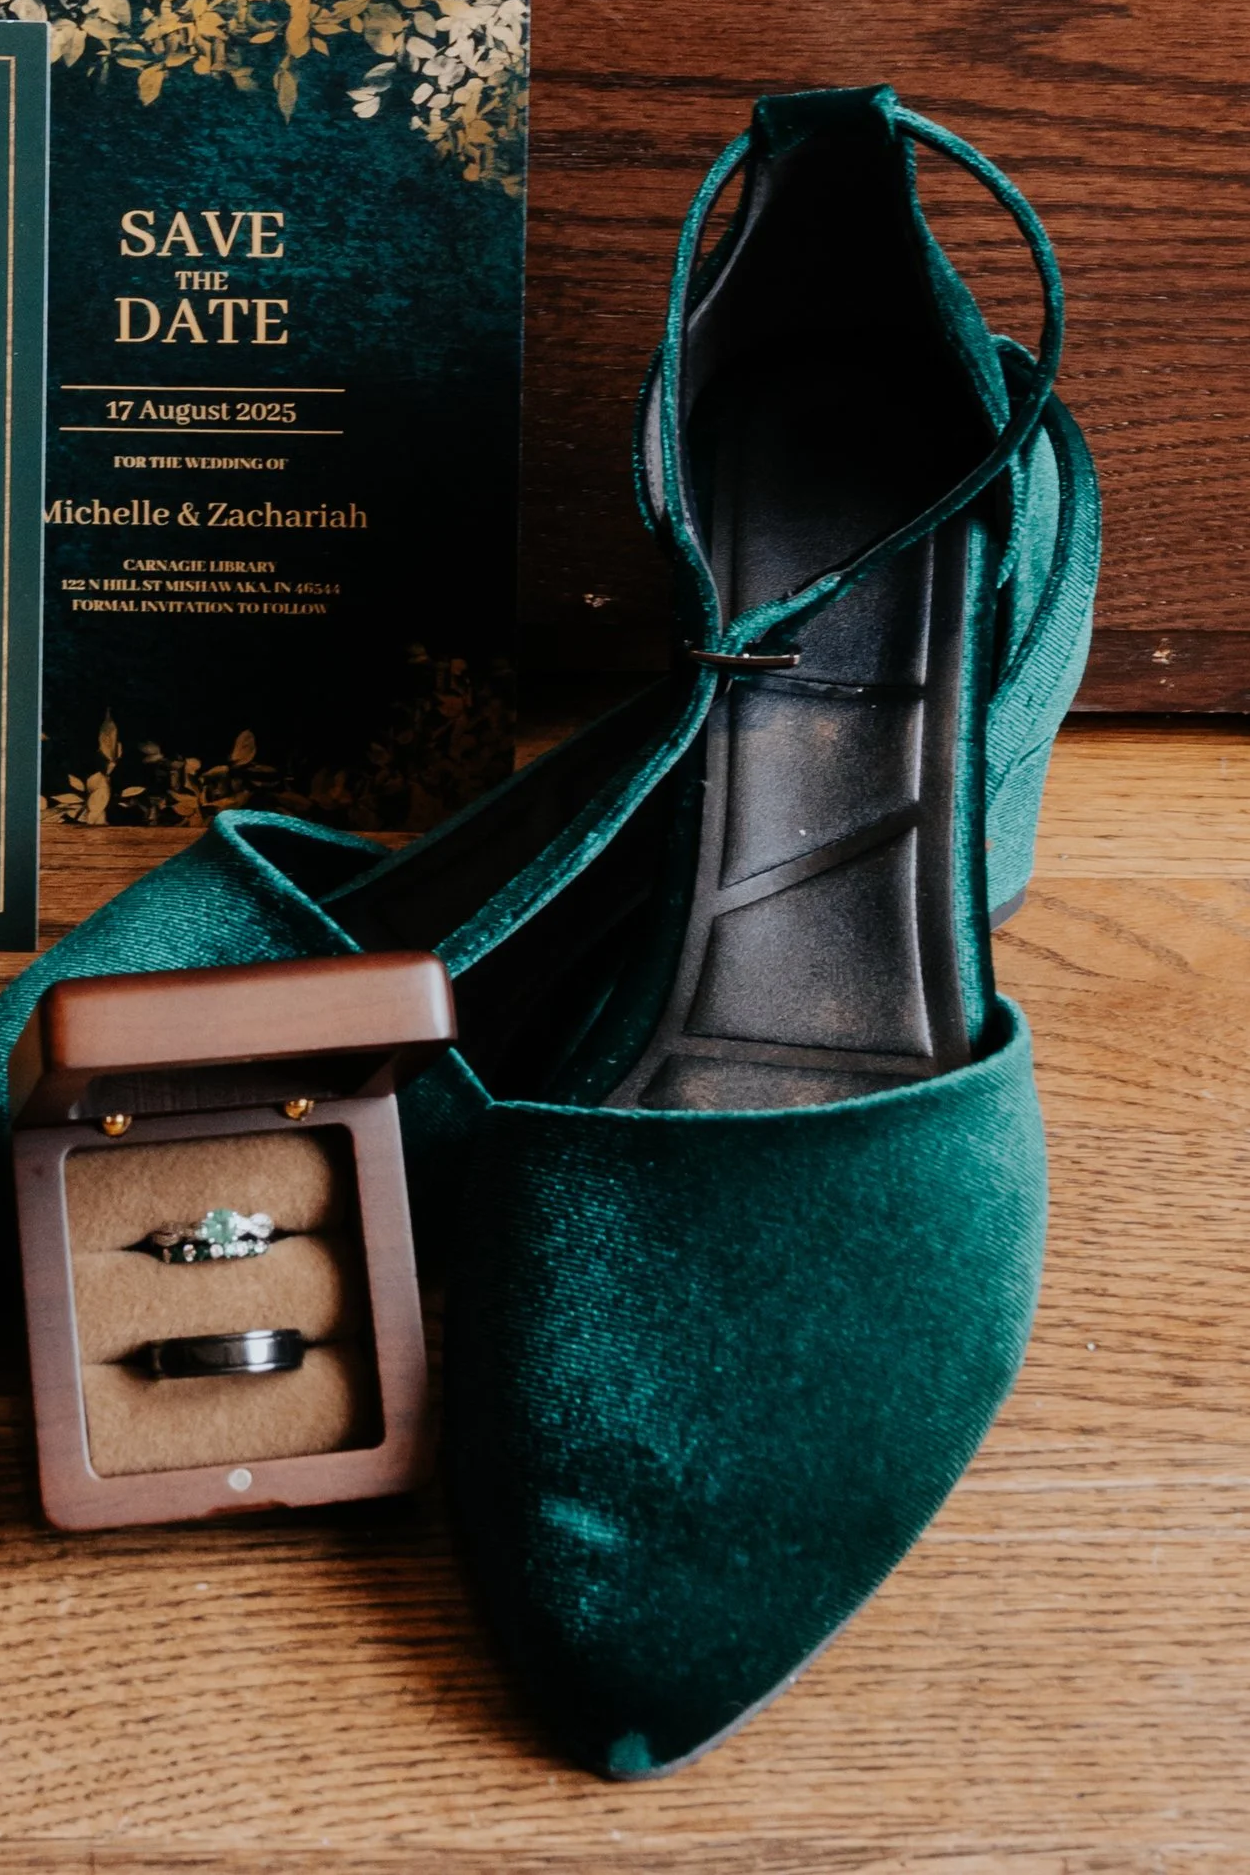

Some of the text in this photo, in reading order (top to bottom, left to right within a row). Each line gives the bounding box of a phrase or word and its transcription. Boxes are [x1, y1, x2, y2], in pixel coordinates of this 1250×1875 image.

[120, 210, 284, 258] SAVE
[175, 271, 229, 291] THE
[115, 297, 288, 344] DATE
[106, 400, 297, 425] 17 August 2025
[114, 456, 289, 471] FOR THE WEDDING OF
[42, 499, 368, 528] Michelle & Zachariah
[123, 559, 277, 573] CARNAGIE LIBRARY
[61, 579, 86, 591] 122
[89, 579, 100, 590] N
[103, 579, 140, 591] HILL
[142, 580, 162, 592] ST
[274, 581, 291, 593] IN
[72, 599, 327, 615] FORMAL INVITATION TO FOLLOW
